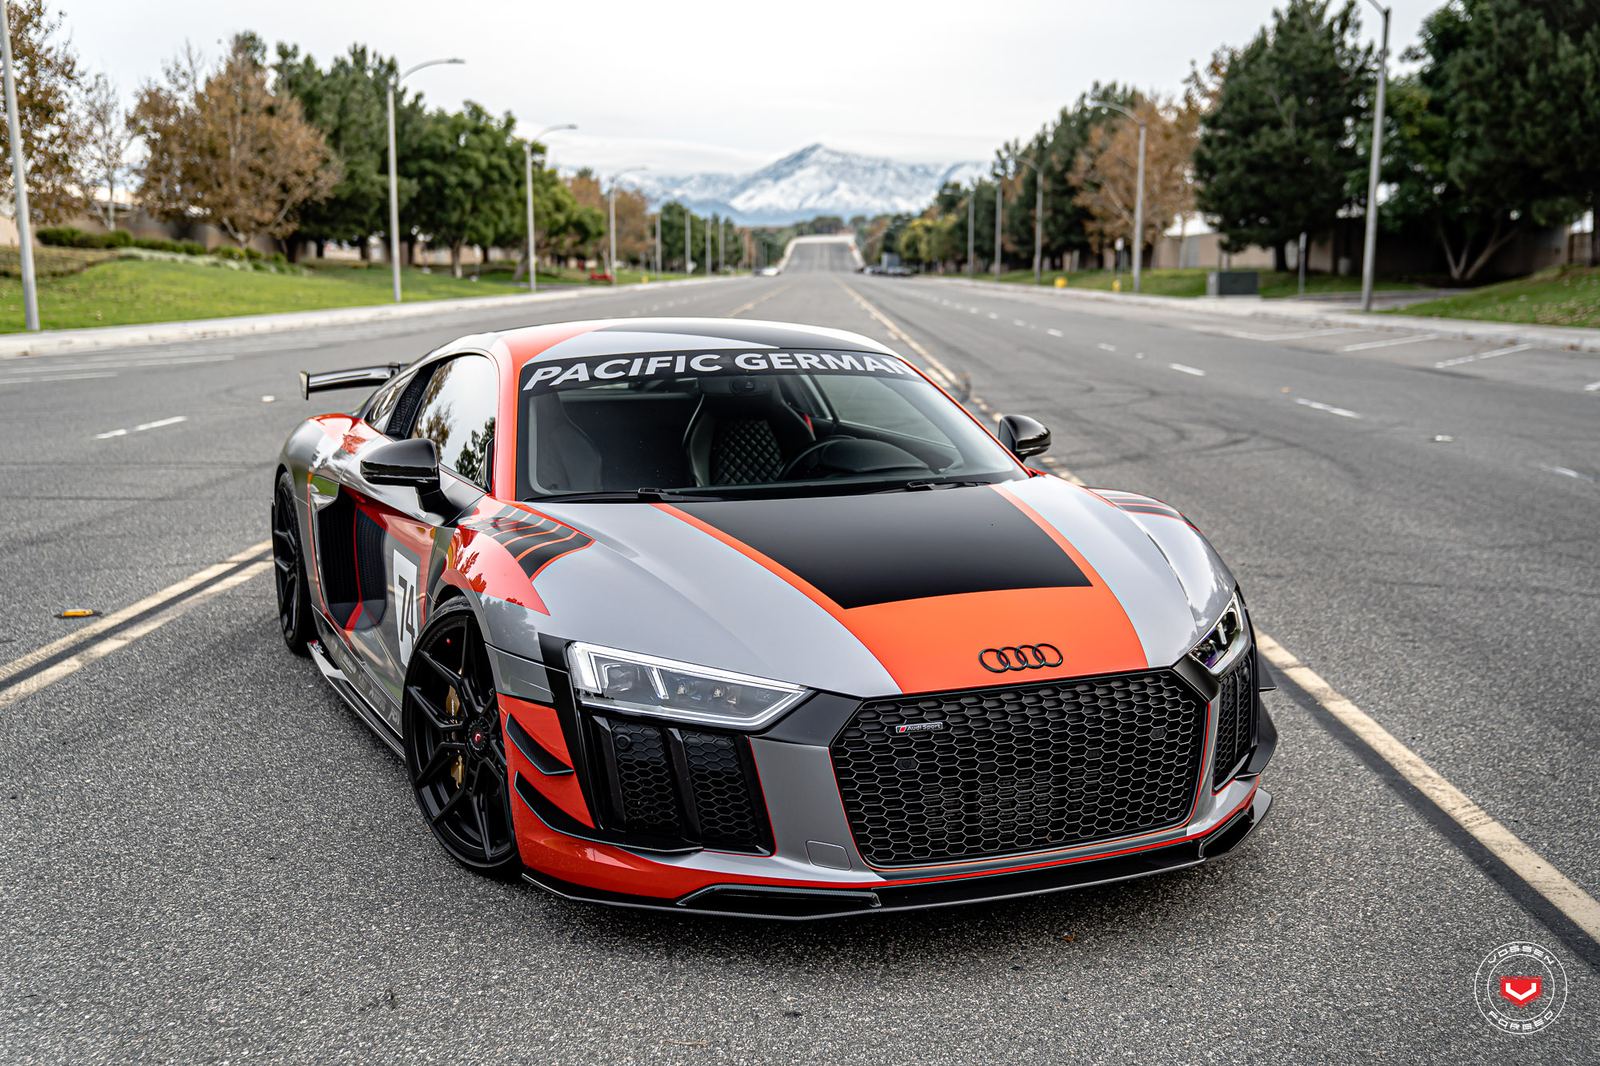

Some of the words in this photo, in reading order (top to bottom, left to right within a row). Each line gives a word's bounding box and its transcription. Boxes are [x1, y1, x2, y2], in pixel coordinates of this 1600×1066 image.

[522, 354, 723, 391] PACIFIC
[734, 352, 920, 377] GERMAN
[398, 574, 415, 651] 74
